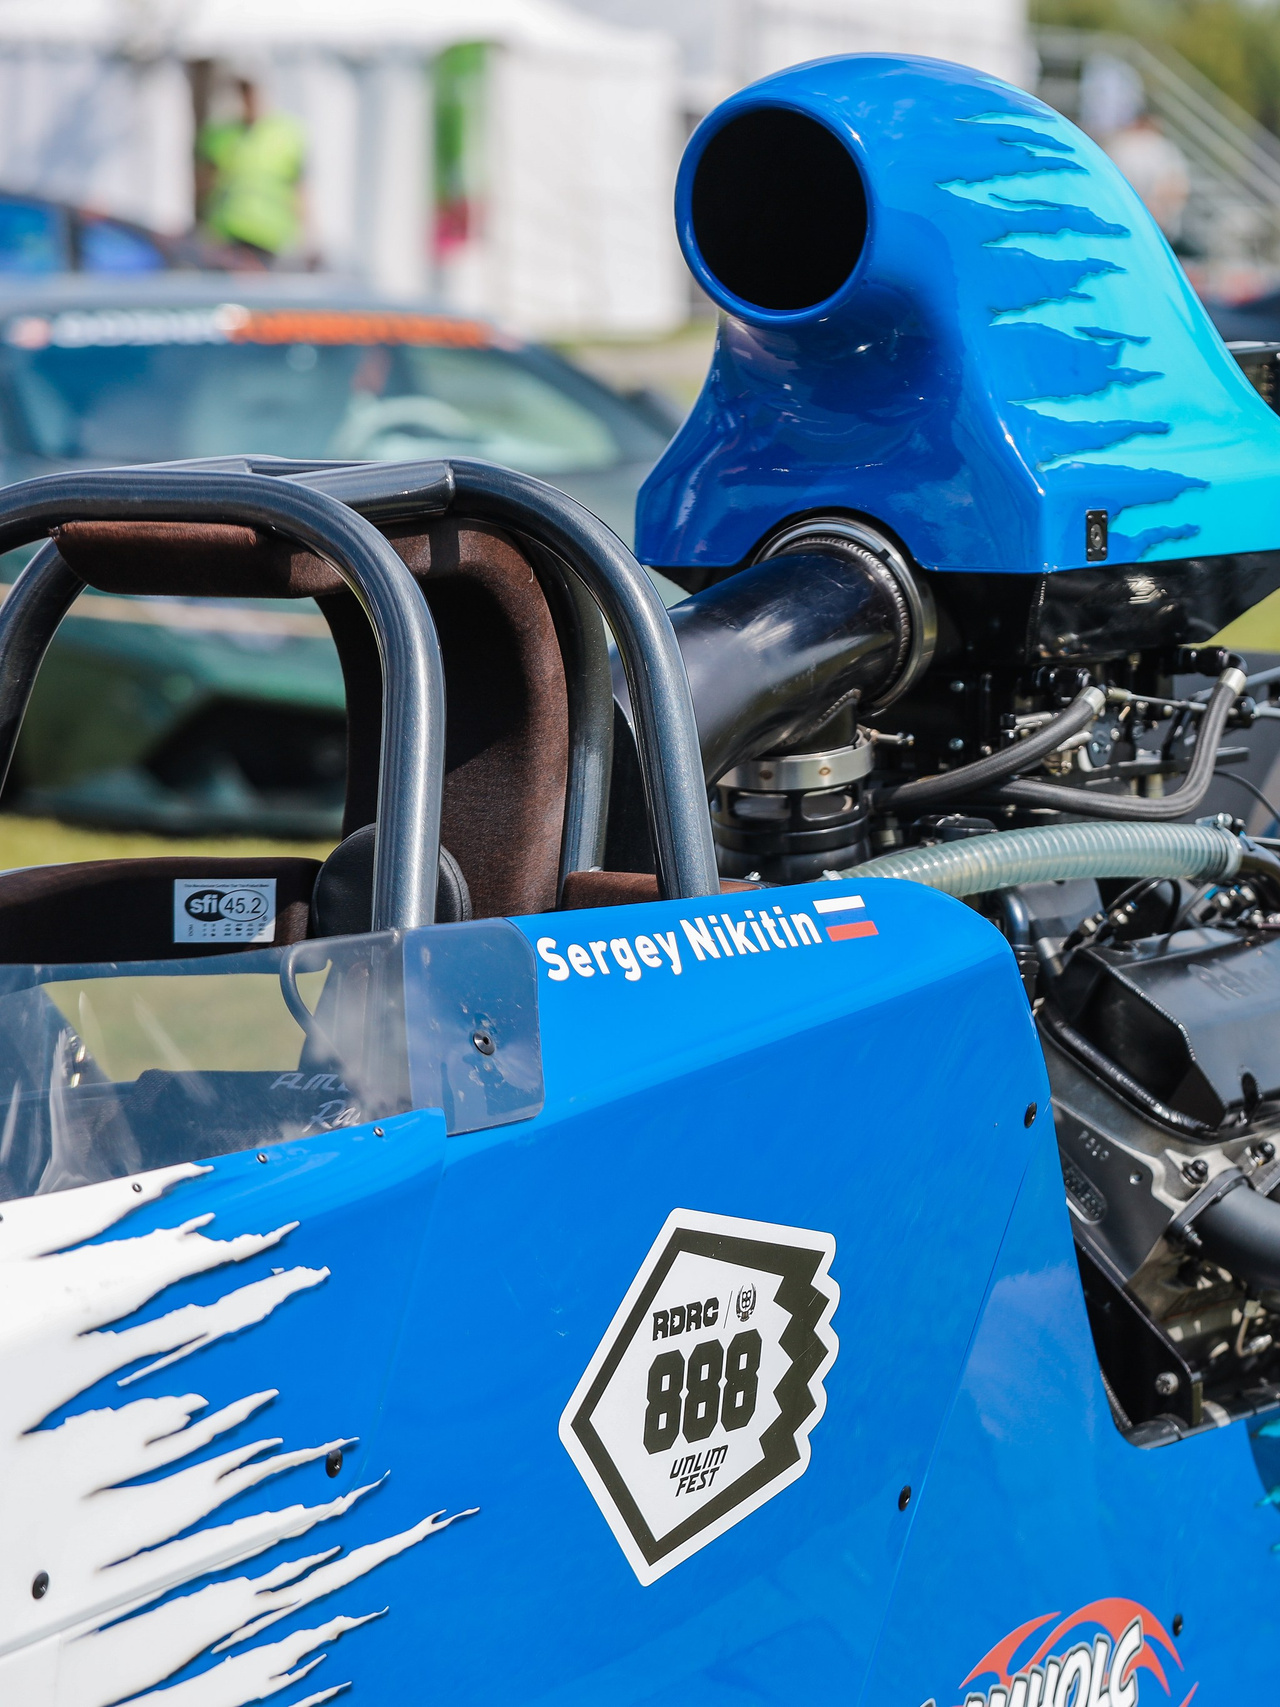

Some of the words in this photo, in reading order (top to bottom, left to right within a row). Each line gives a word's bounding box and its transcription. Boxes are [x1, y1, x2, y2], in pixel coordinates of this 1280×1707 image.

[189, 893, 219, 914] sfi
[224, 897, 262, 914] 45.2
[535, 930, 683, 982] Sergey
[679, 905, 823, 962] Nikitin
[652, 1296, 720, 1341] RDRC
[643, 1328, 763, 1456] 888
[675, 1466, 721, 1498] FEST
